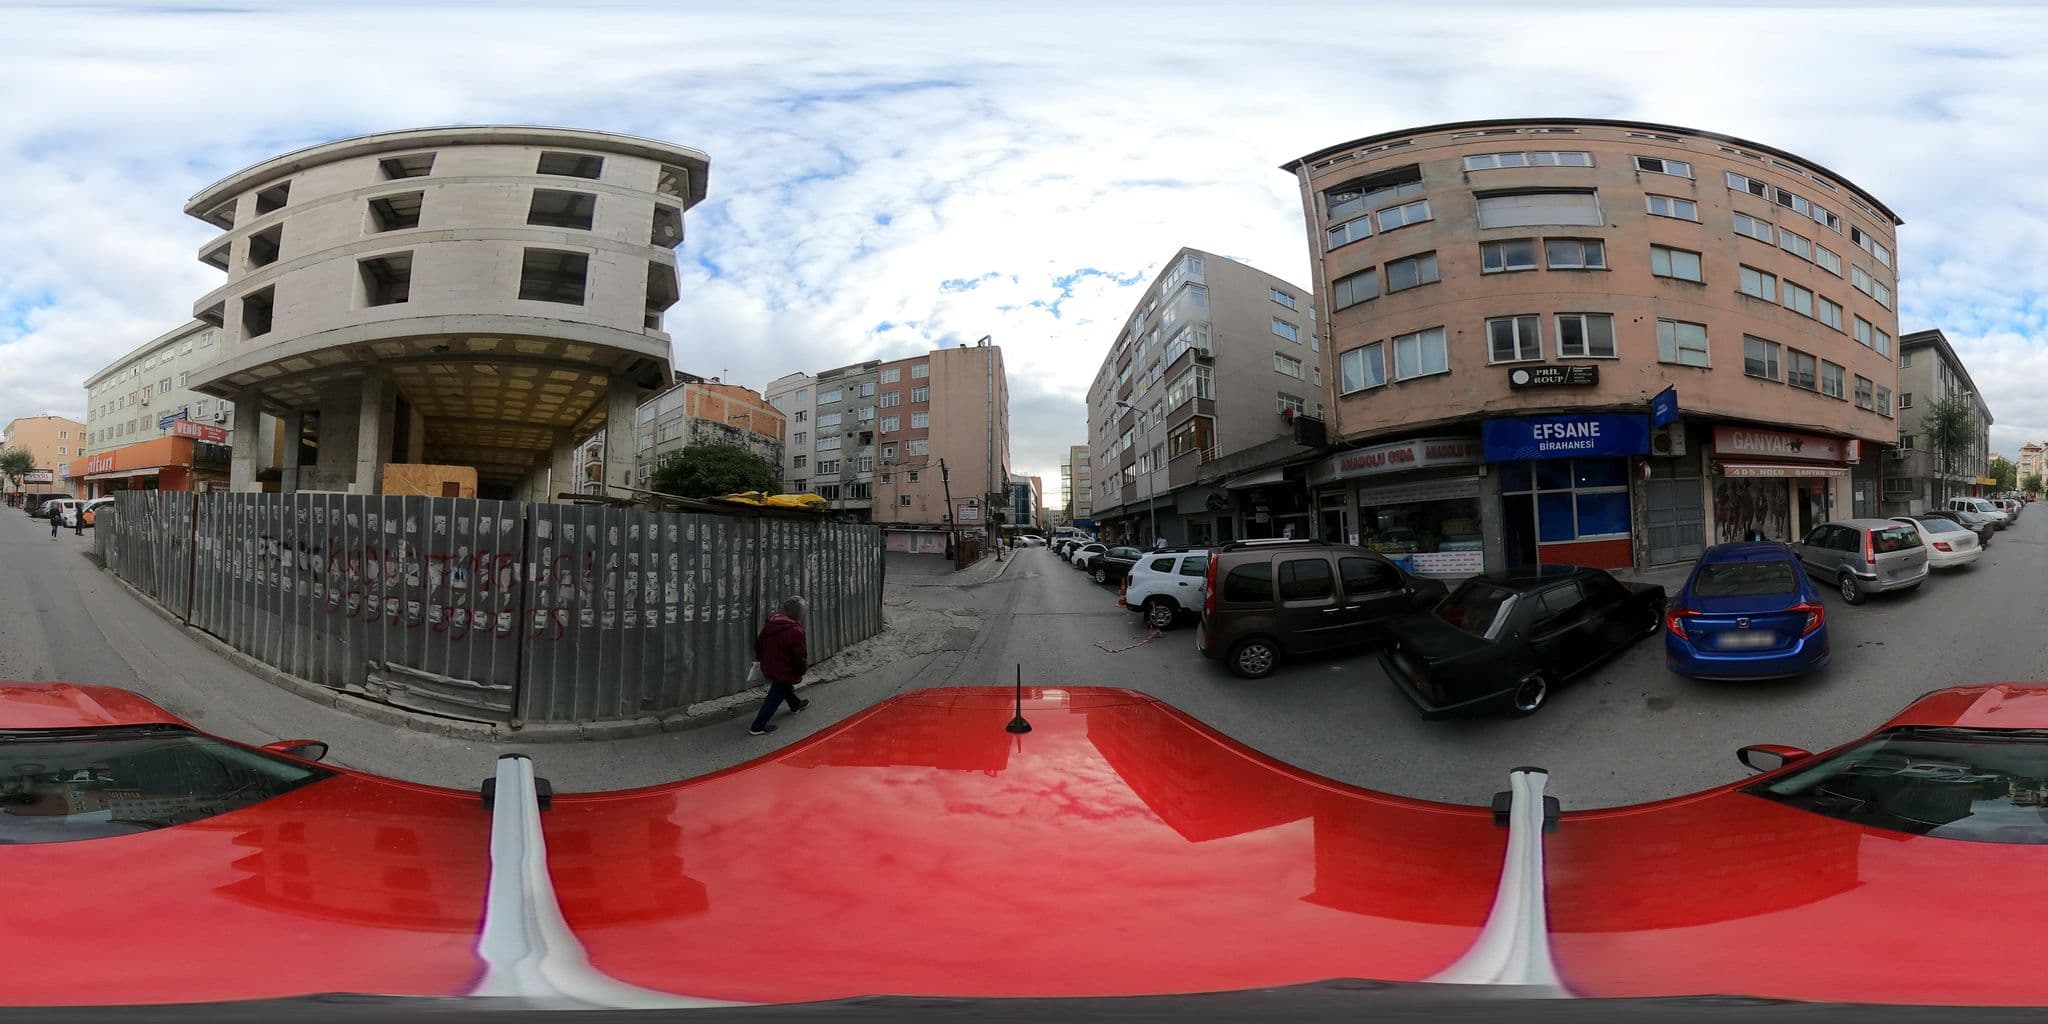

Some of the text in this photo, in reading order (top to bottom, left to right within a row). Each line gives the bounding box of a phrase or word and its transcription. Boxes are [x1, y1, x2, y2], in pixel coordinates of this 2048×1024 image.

[177, 421, 202, 437] VENUS
[1533, 422, 1601, 439] EFSANE
[1539, 438, 1595, 451] BİRAHANESİ
[1732, 432, 1793, 454] GANYAN
[1425, 445, 1464, 459] ANADOLU
[1340, 452, 1386, 473] ANADOLU
